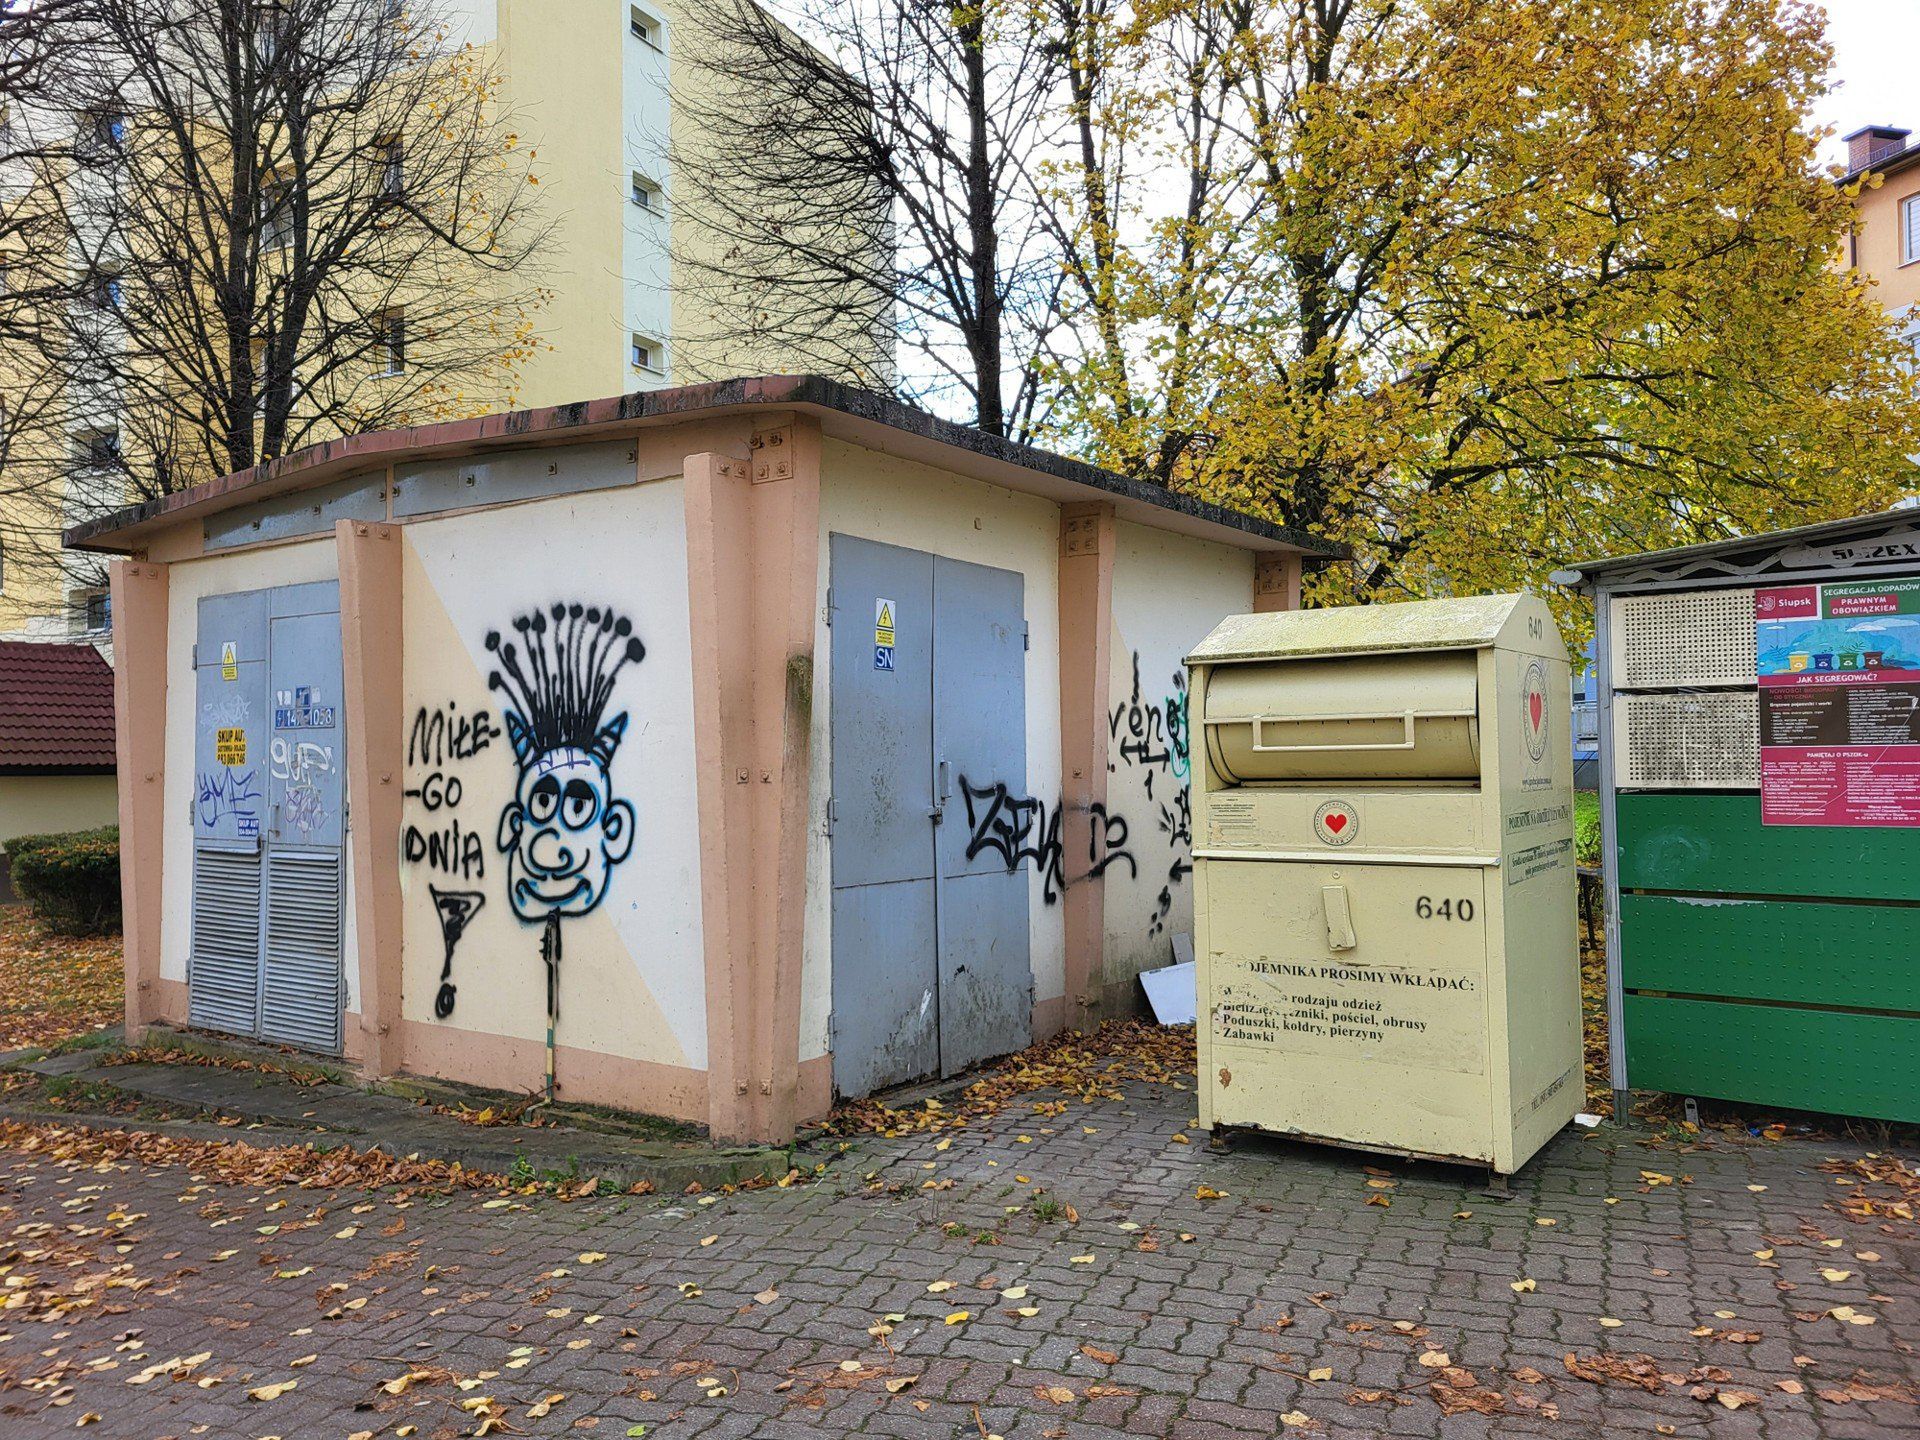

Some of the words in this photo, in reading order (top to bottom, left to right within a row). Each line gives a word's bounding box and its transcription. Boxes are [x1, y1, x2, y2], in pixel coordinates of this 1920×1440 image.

[1823, 586, 1876, 596] SEGREGACJA
[1877, 583, 1920, 592] ODPADÓW
[1841, 596, 1887, 606] PRAWNYM
[1832, 605, 1897, 615] OBOWIĄZKIEM
[1528, 616, 1543, 641] 640
[876, 647, 893, 668] SN
[1796, 676, 1813, 684] JAK
[1814, 673, 1878, 683] SEGREGOWAĆ?
[1416, 895, 1475, 922] 640
[1320, 967, 1386, 983] PROSIMY
[1291, 994, 1338, 1009] rodzaju
[1342, 998, 1382, 1012] odzież
[1223, 1013, 1279, 1031] Poduszki,
[1283, 1020, 1326, 1036] kołdry,
[1330, 1025, 1385, 1043] pierzyny
[1332, 1012, 1379, 1027] pościel,
[1383, 1016, 1428, 1033] obrusy
[1223, 1027, 1274, 1043] Zabawki
